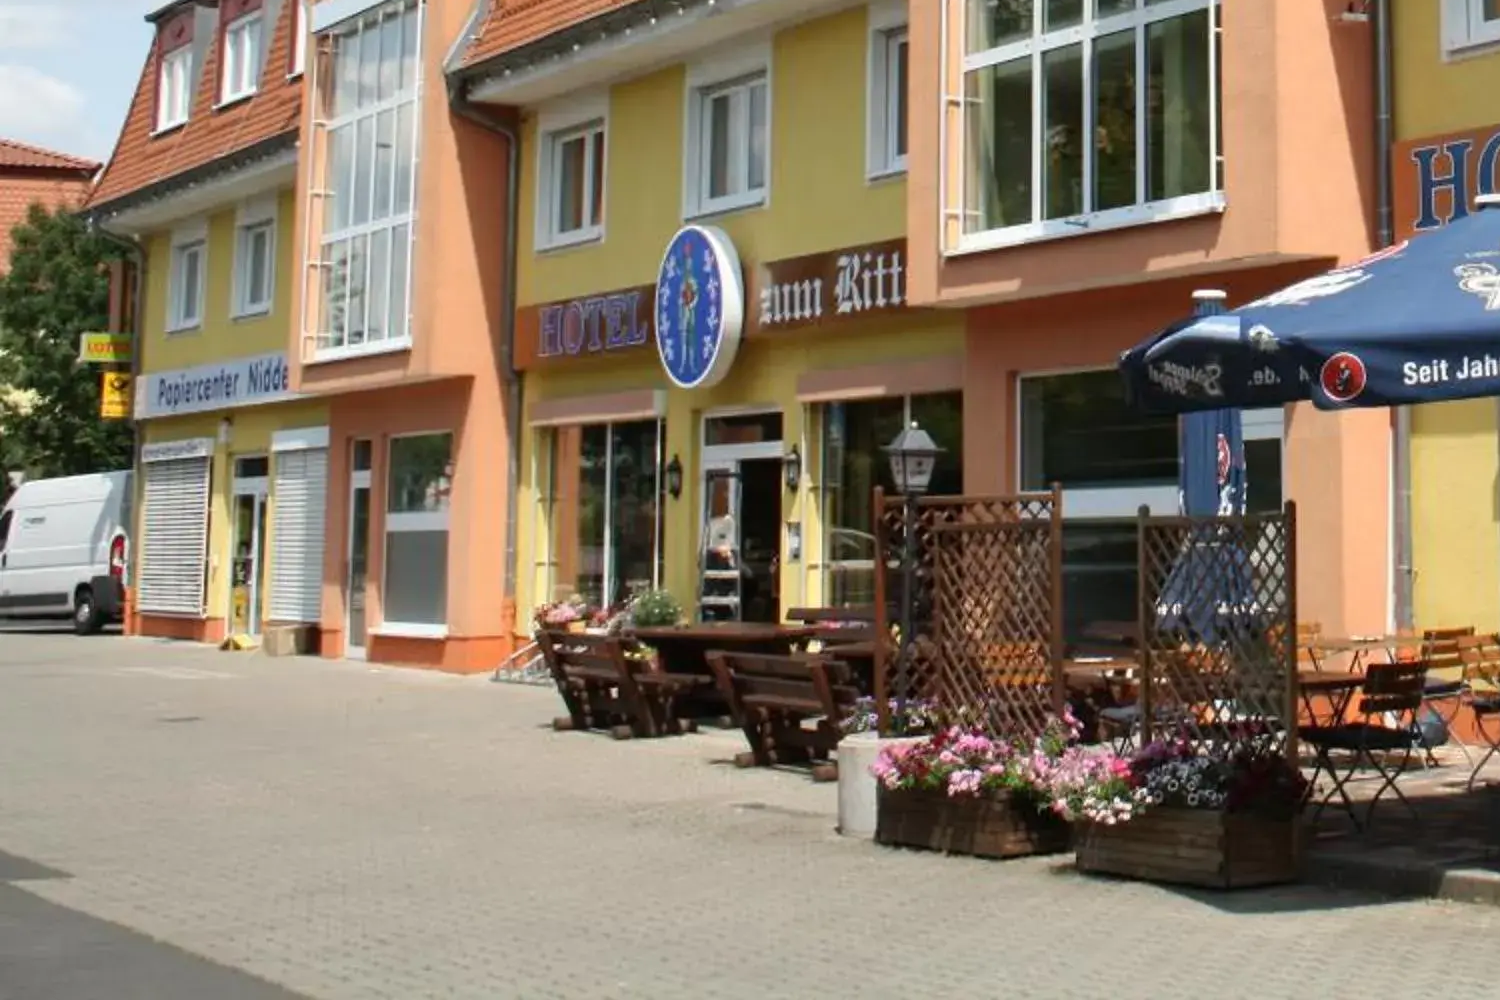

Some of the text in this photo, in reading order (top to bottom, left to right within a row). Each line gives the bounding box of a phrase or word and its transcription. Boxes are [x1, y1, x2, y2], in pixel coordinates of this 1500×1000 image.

[537, 250, 907, 357] HOTEL zum Ritt
[158, 368, 240, 409] Papiercenter
[1403, 356, 1448, 386] Seit
